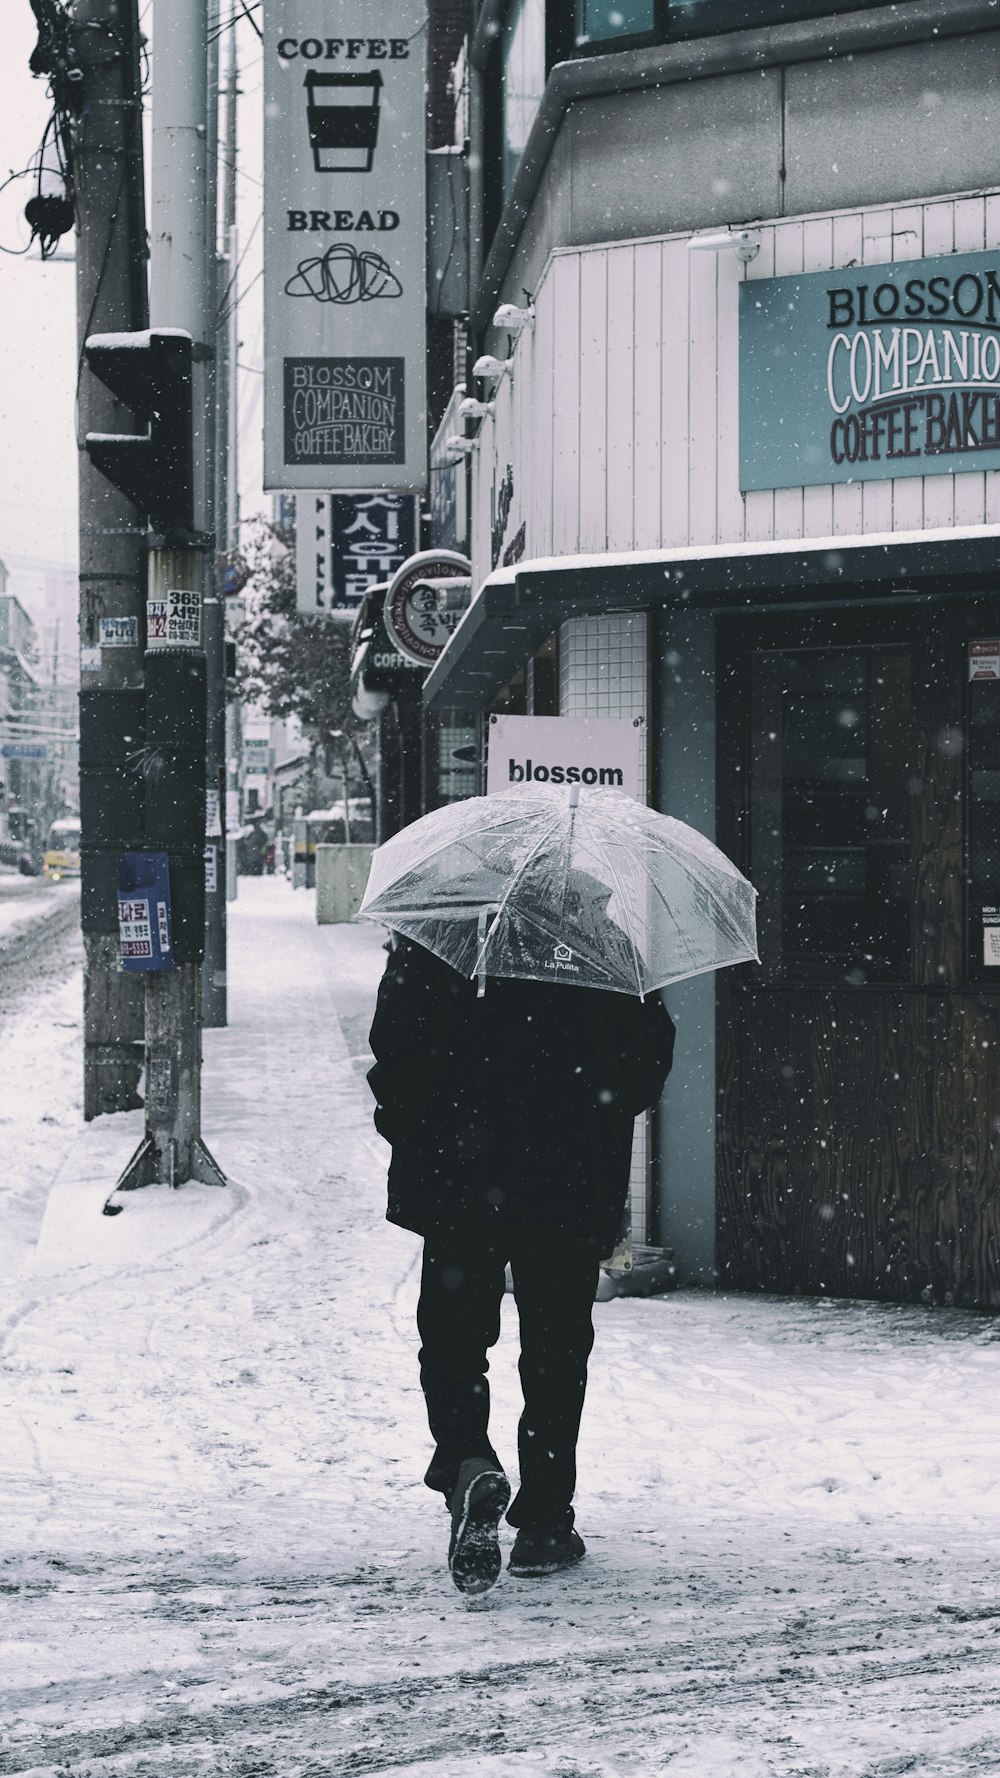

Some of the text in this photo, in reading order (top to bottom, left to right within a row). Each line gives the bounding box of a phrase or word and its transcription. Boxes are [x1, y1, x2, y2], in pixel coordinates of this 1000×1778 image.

[277, 38, 409, 59] COFFEE
[287, 210, 400, 231] BREAD
[293, 366, 392, 397] BLOSSOM
[293, 389, 396, 430] COMPANION
[294, 424, 396, 455] COFFEE BAKERY
[831, 397, 924, 464] COFFEE
[169, 592, 199, 606] 365
[169, 605, 199, 620] 서민
[509, 759, 623, 785] blossom
[545, 960, 555, 968] La
